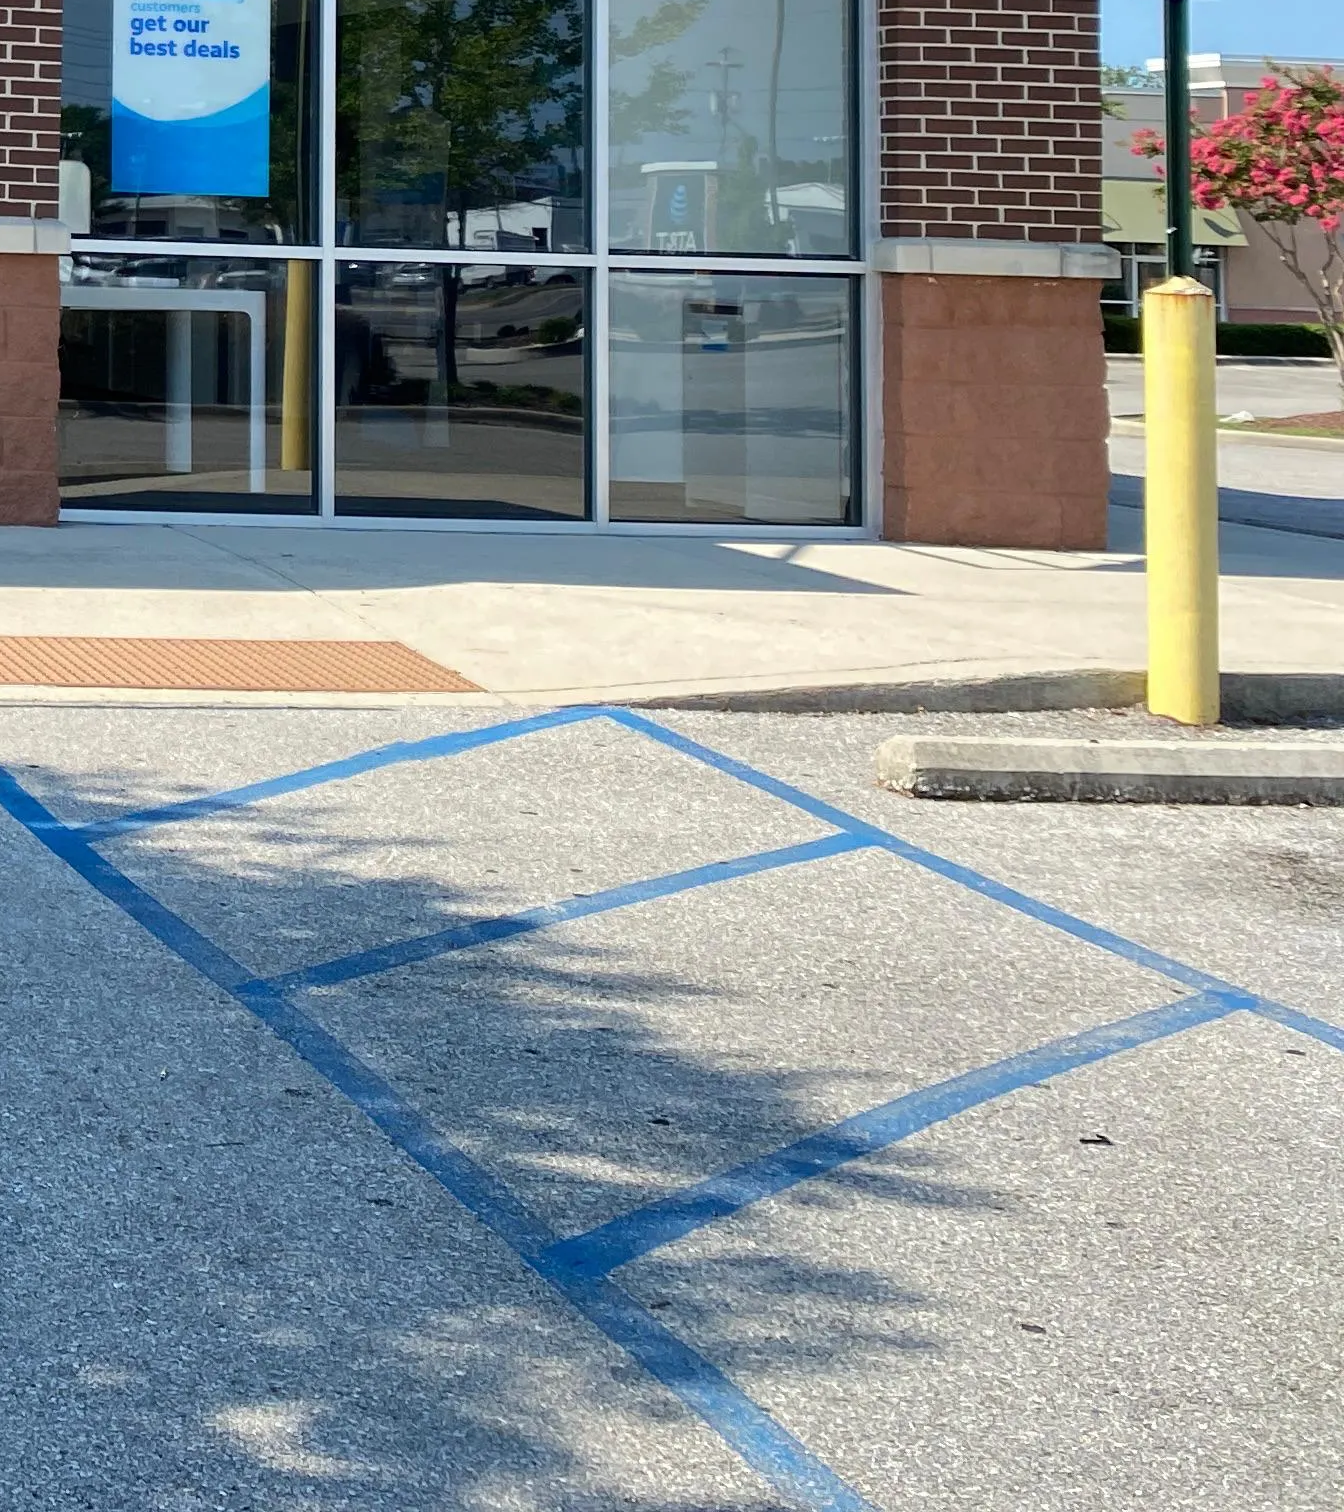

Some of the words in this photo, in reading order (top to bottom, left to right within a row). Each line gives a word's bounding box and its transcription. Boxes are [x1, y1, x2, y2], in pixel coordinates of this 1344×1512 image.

[130, 2, 201, 13] customers
[131, 16, 167, 36] get
[173, 19, 210, 33] our
[130, 37, 178, 56] best
[183, 40, 240, 59] deals
